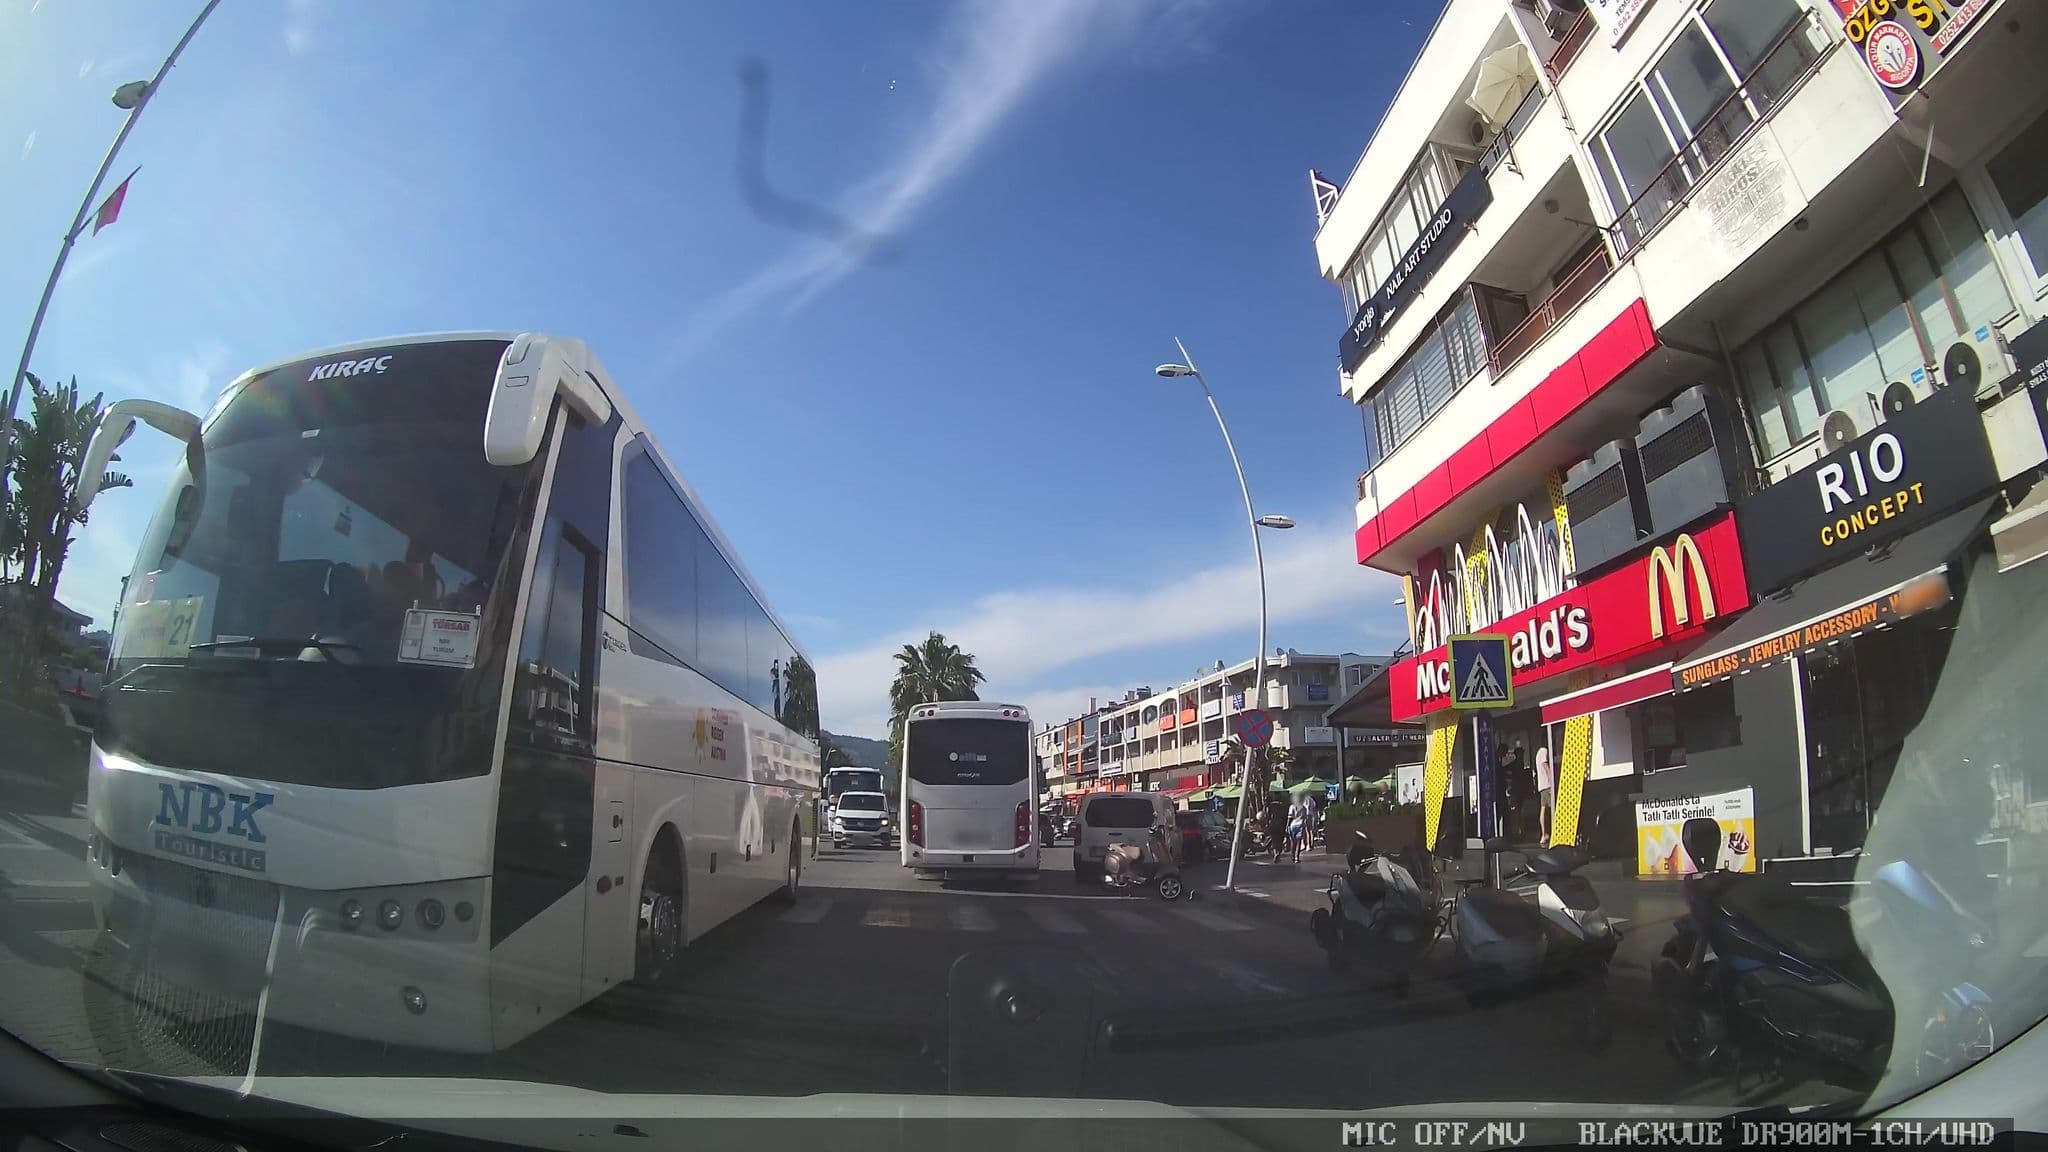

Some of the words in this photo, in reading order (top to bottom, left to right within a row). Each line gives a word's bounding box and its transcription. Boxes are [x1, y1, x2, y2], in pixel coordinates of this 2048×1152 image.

[1938, 21, 1959, 45] 0252
[1957, 5, 1973, 25] 413
[1386, 271, 1404, 300] NAIL
[1404, 249, 1421, 278] ART
[1420, 208, 1452, 255] STUDIO
[308, 355, 393, 382] KIRAÇ
[1815, 432, 1904, 514] RIO
[1820, 482, 1924, 547] CONCEPT
[1416, 604, 1589, 701] Mcald's
[1682, 653, 1739, 686] SUNGLASS
[1748, 630, 1801, 665] JEWELRY
[1804, 602, 1878, 646] ACCESSORY
[155, 781, 274, 843] NBK
[1643, 811, 1661, 822] Tatlı
[1663, 809, 1680, 820] Tatlı
[1681, 805, 1715, 819] Serinle!
[158, 833, 263, 869] Touristic
